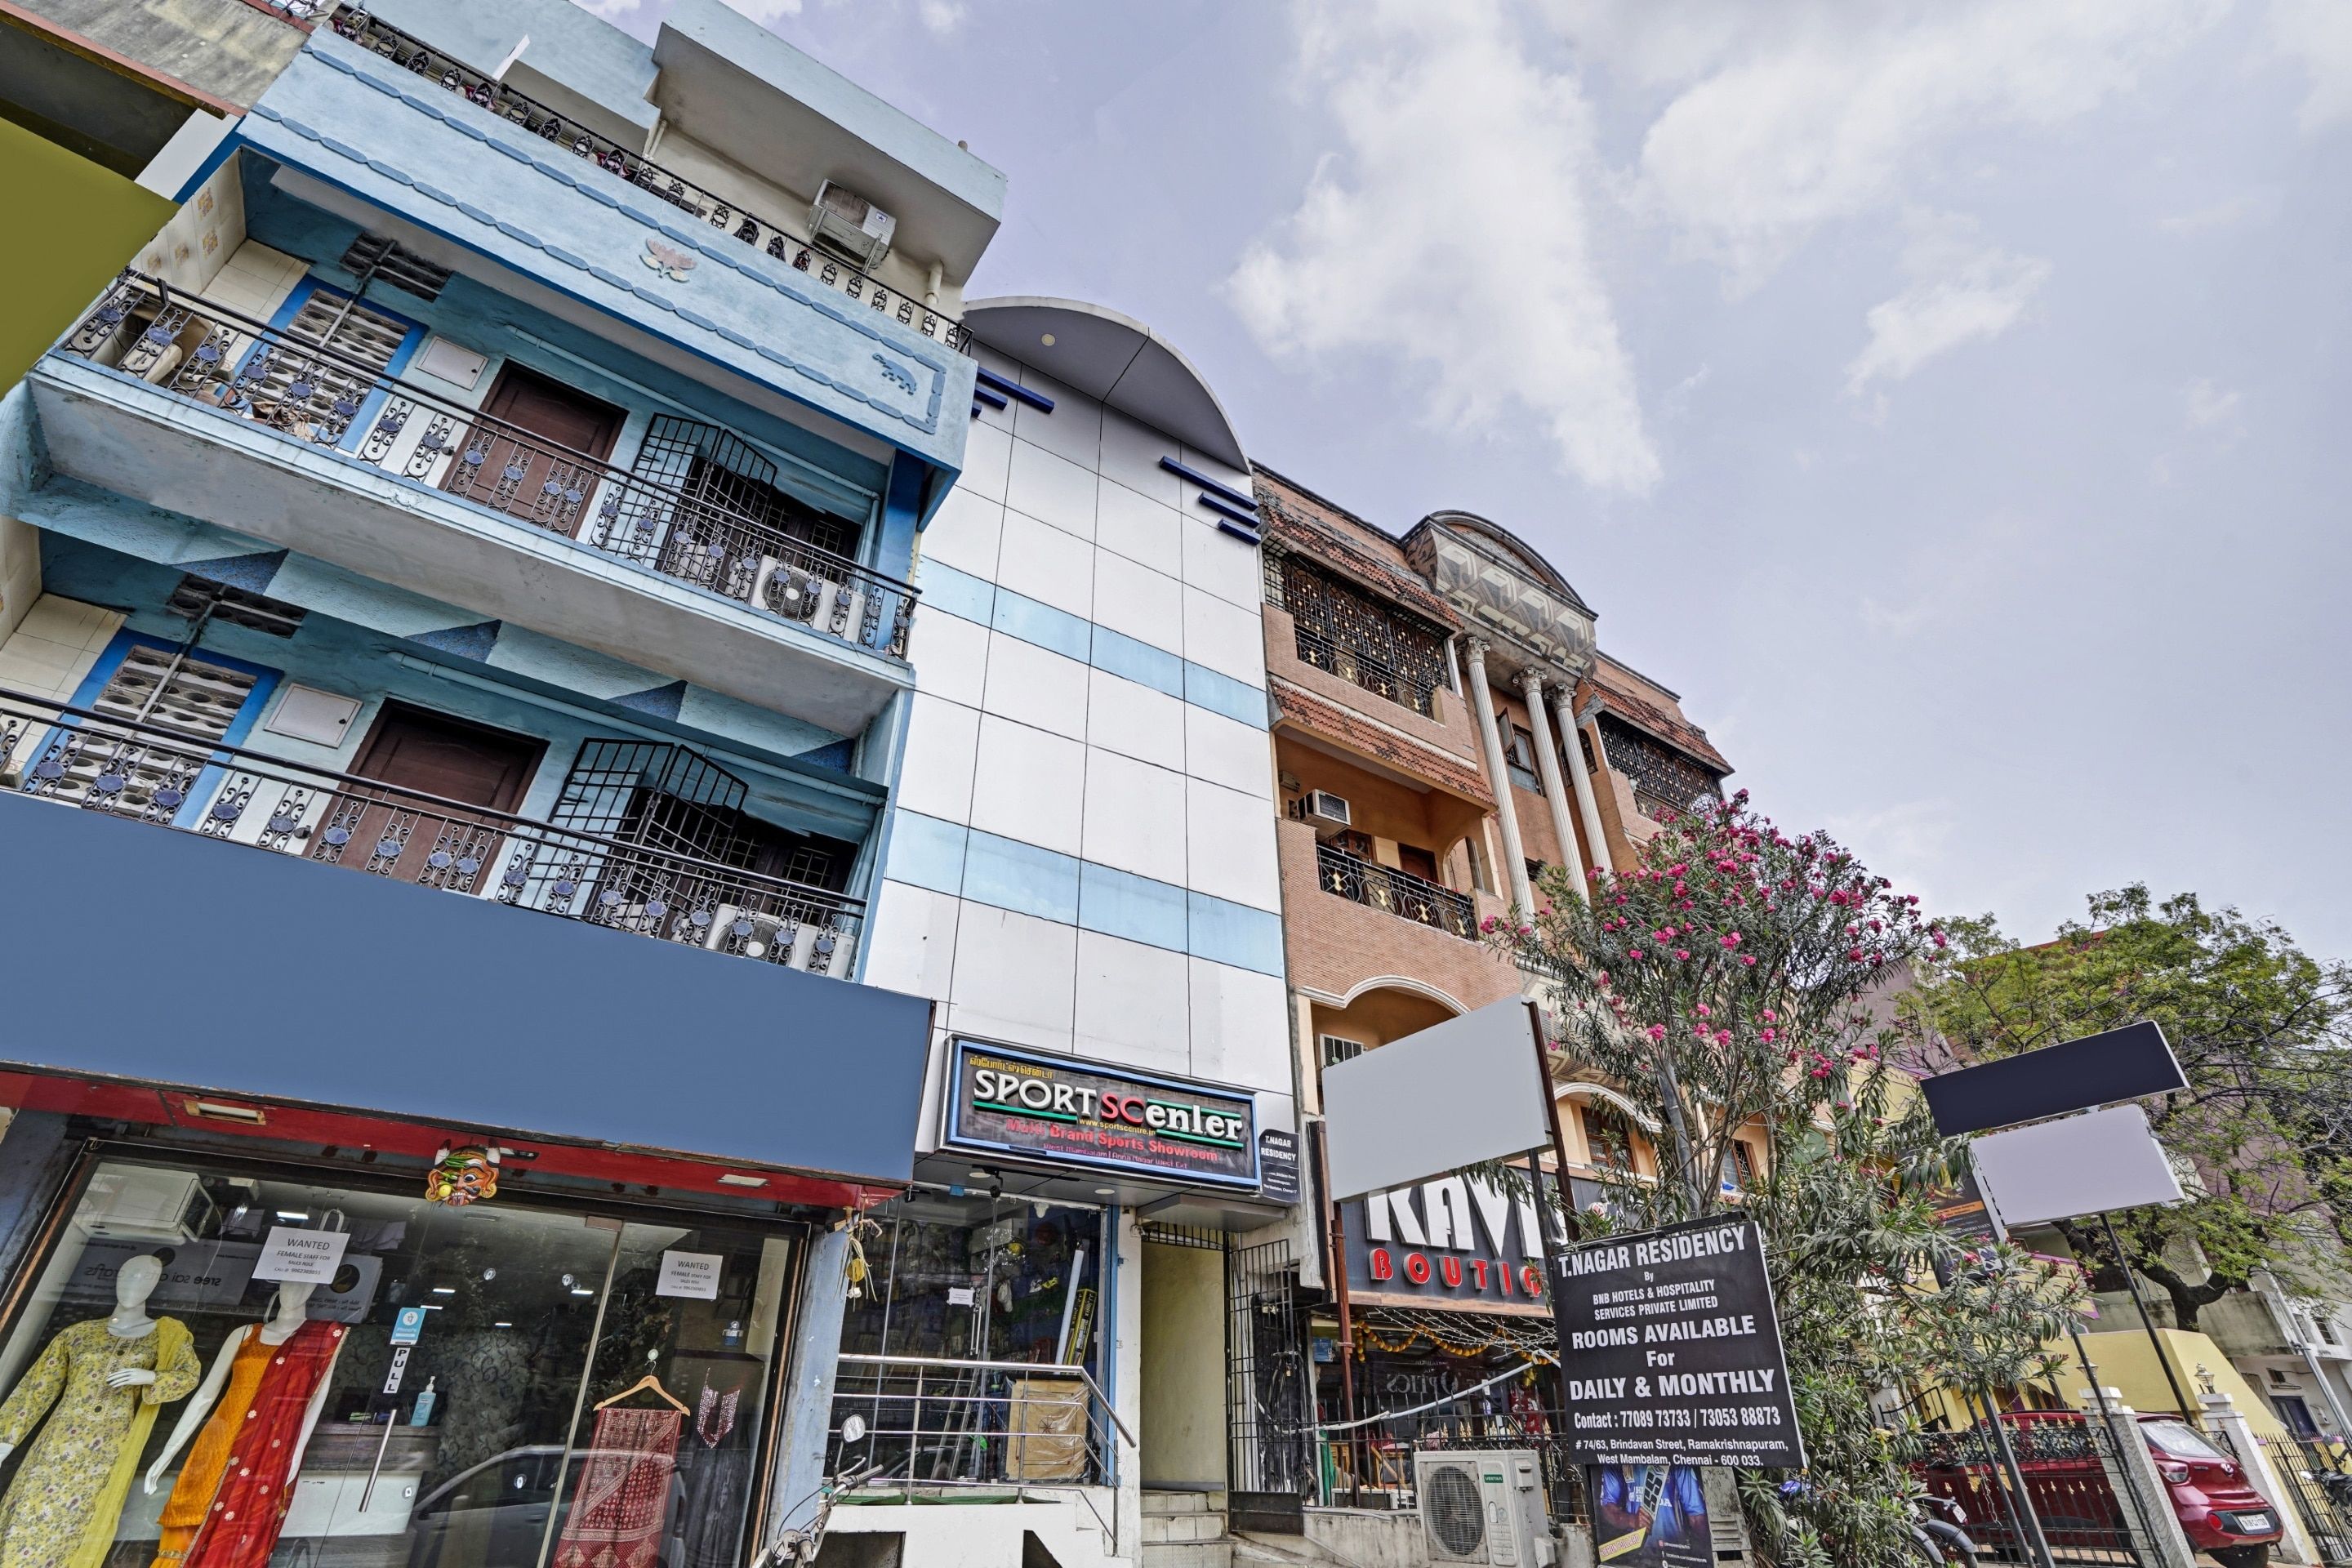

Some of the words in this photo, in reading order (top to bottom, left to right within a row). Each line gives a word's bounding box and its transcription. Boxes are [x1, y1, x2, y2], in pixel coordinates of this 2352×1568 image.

[1005, 1118, 1045, 1136] Multi
[1049, 1123, 1094, 1143] Brand
[1098, 1130, 1144, 1150] Sports
[1148, 1140, 1218, 1161] Showroom
[1265, 1135, 1292, 1148] T.NAGAR
[1044, 1143, 1064, 1152] West
[1066, 1145, 1107, 1157] Mambalam
[1111, 1152, 1131, 1161] Anna
[1132, 1156, 1153, 1165] Nagar
[1155, 1158, 1174, 1167] West
[1176, 1160, 1188, 1169] Ext
[1260, 1147, 1297, 1161] RESIDENCY
[287, 1238, 330, 1250] WANTED
[1558, 1245, 1631, 1277] T.NAGAR
[1636, 1226, 1746, 1266] RESIDENCY
[278, 1250, 303, 1259] FEMALE
[303, 1253, 319, 1261] STAFF
[678, 1260, 710, 1271] WANTED
[1644, 1271, 1654, 1283] By
[1592, 1293, 1610, 1306] BNB
[1612, 1288, 1645, 1303] HOTELS
[1647, 1287, 1655, 1298] &
[1656, 1279, 1716, 1298] HOSPITALITY
[1594, 1304, 1636, 1321] SERVICES
[1638, 1299, 1677, 1316] PRIVATE
[1679, 1295, 1719, 1312] LIMITED
[1571, 1326, 1638, 1349] ROOMS
[1644, 1315, 1757, 1343] AVAILABLE
[1646, 1350, 1674, 1367] For
[387, 1349, 408, 1392] PULL
[1570, 1377, 1626, 1400] DAILY
[1634, 1376, 1652, 1397] &
[1659, 1369, 1775, 1396] MONTHLY
[1575, 1412, 1613, 1429] Contact
[1619, 1410, 1653, 1428] 77089
[1655, 1409, 1690, 1427] 73733
[1699, 1406, 1739, 1426] 73053
[1741, 1405, 1781, 1426] 88873
[1583, 1439, 1609, 1451] 74/63,
[1610, 1439, 1654, 1450] Brindavan
[1655, 1438, 1686, 1451] Street,
[1688, 1439, 1788, 1452] Ramakrishnapuram,
[1597, 1454, 1619, 1464] West
[1620, 1454, 1671, 1466] Mambalam,
[1673, 1454, 1713, 1466] Chennai
[1721, 1455, 1740, 1466] 600
[1741, 1456, 1764, 1467] 033.
